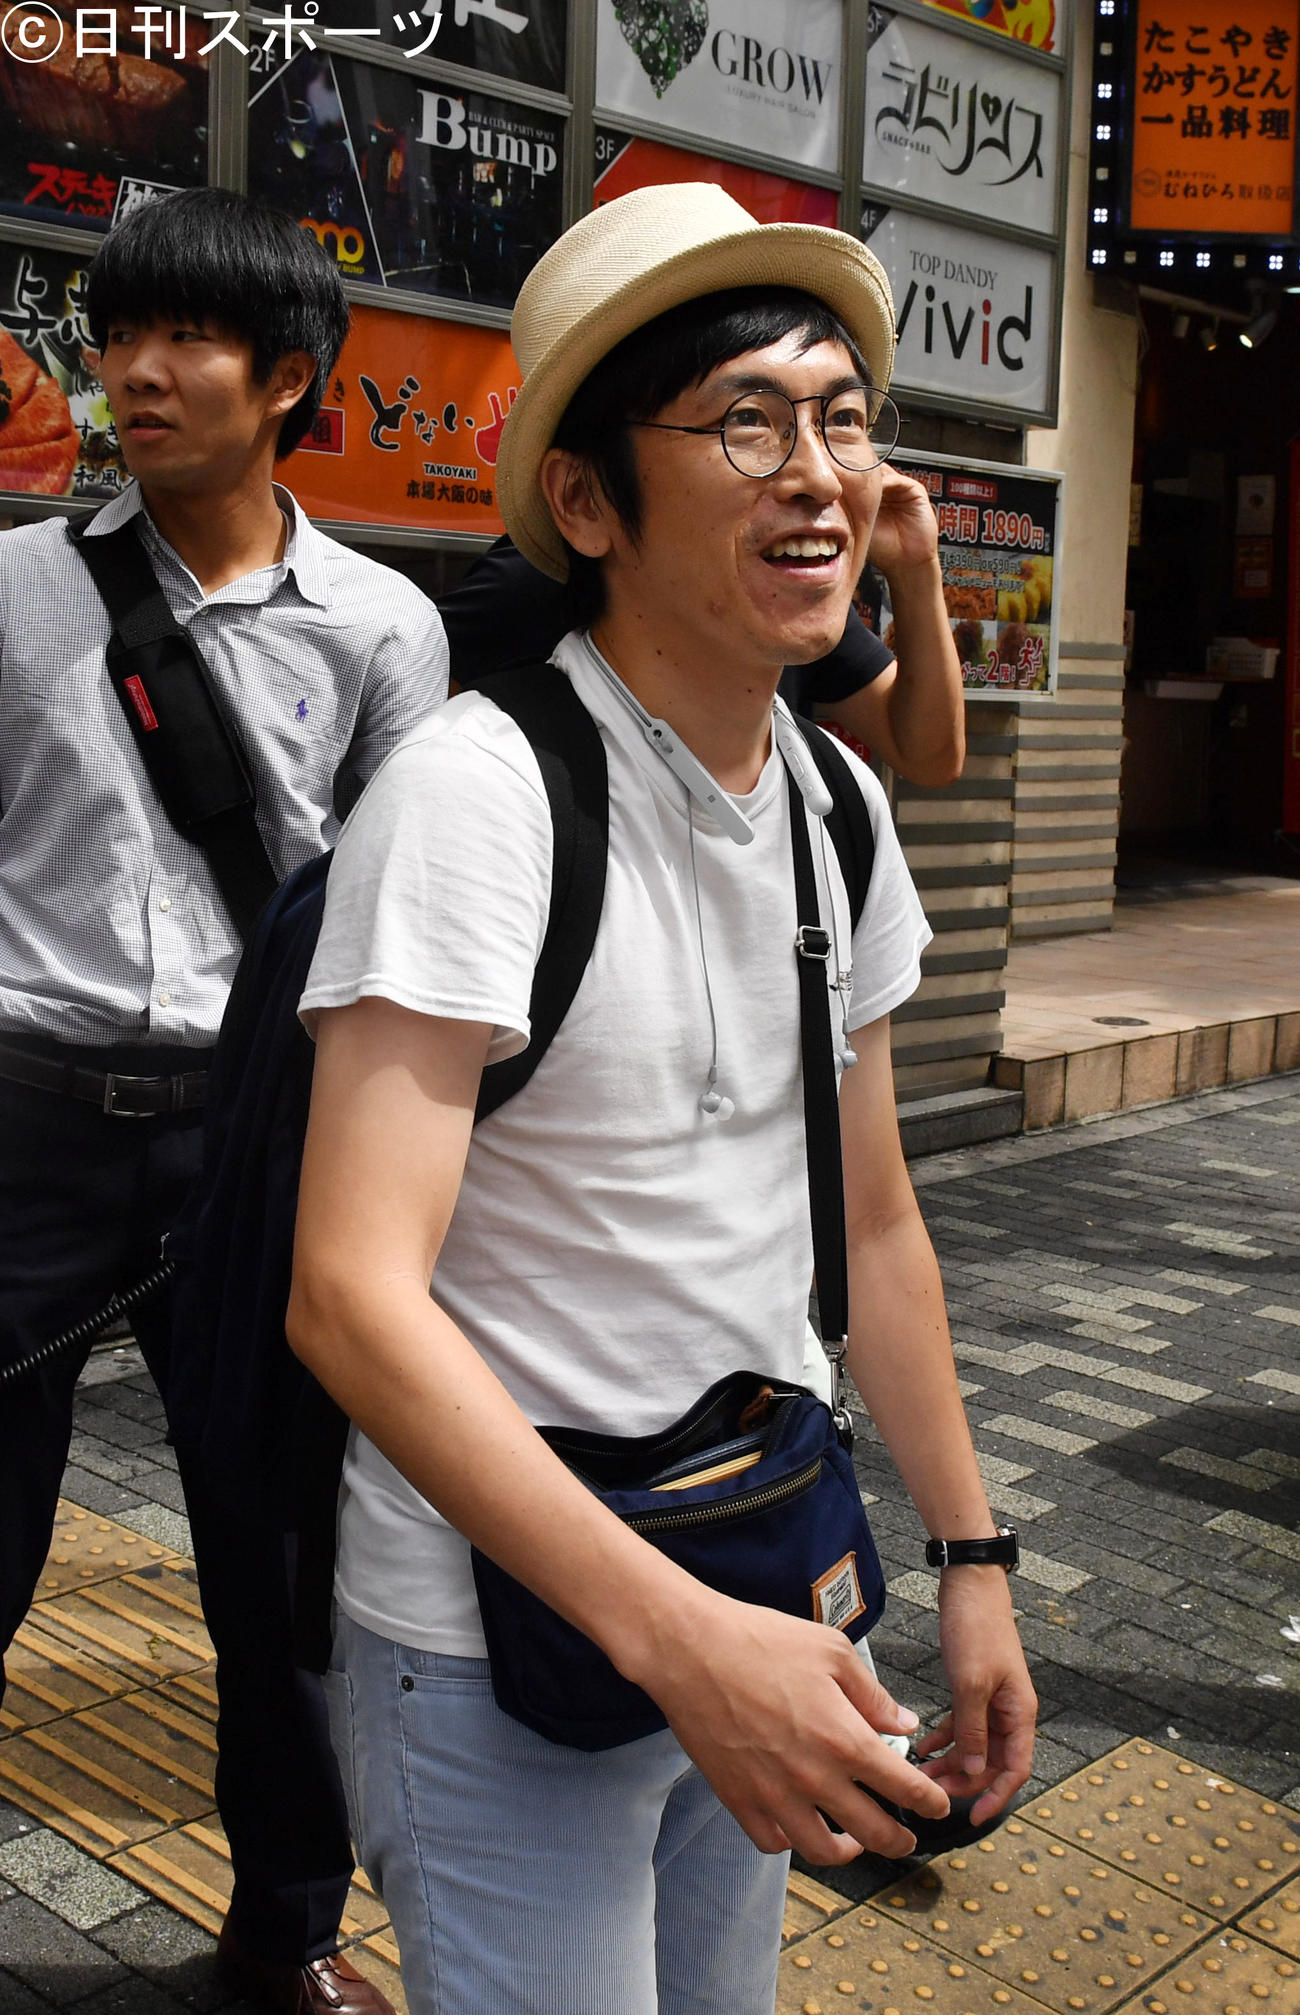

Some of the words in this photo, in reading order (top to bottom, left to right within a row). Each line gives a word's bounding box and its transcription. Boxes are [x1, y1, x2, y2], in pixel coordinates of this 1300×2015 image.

[1144, 21, 1291, 60] たこやき
[711, 29, 833, 105] GROW
[1142, 62, 1292, 99] かすうどん
[415, 89, 558, 176] Bump
[1141, 105, 1290, 140] 一品料理
[595, 136, 615, 160] 3F
[860, 210, 876, 229] 4F
[910, 250, 941, 275] TOP
[944, 260, 998, 290] DANDY
[423, 462, 477, 480] TAKOYAKI
[406, 480, 493, 506] 本場大阪の味
[932, 501, 979, 543] 時間
[982, 509, 1044, 550] 1890円
